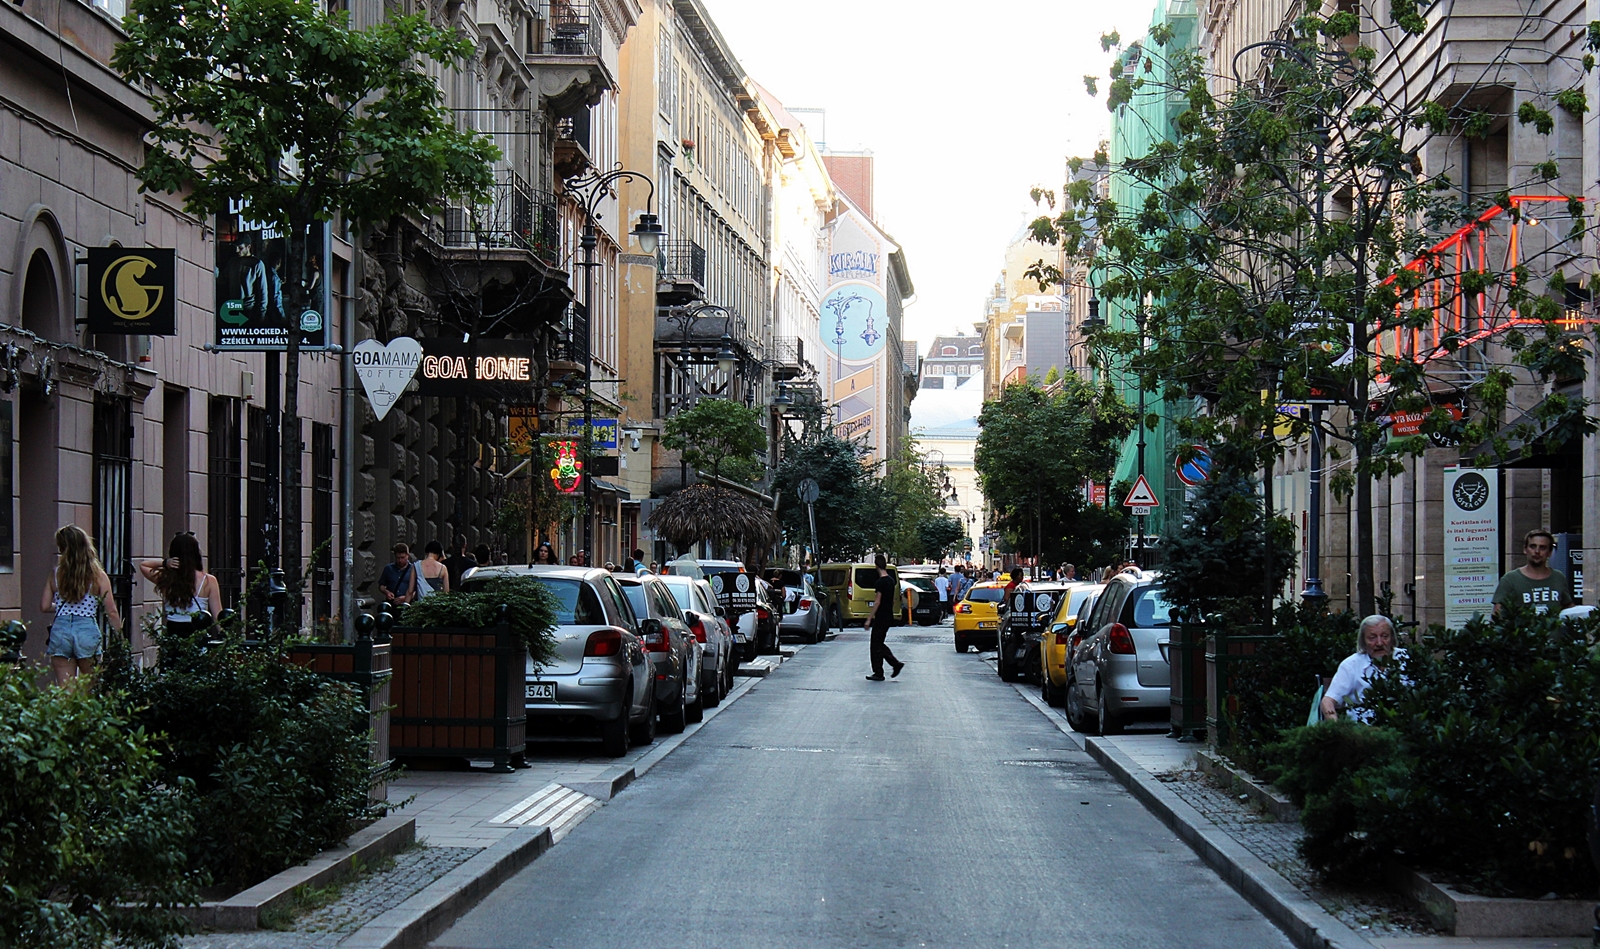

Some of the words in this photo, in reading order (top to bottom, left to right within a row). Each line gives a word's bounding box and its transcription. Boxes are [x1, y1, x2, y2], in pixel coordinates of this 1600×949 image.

[221, 328, 289, 336] WWW.LOCKED.H
[221, 337, 255, 345] SZÉKELY
[257, 336, 289, 345] MIHÁLY
[352, 351, 419, 366] GOAMAMA
[423, 355, 467, 379] GOA
[358, 369, 414, 379] COFFEE
[850, 378, 856, 391] A
[1522, 590, 1559, 604] BEER
